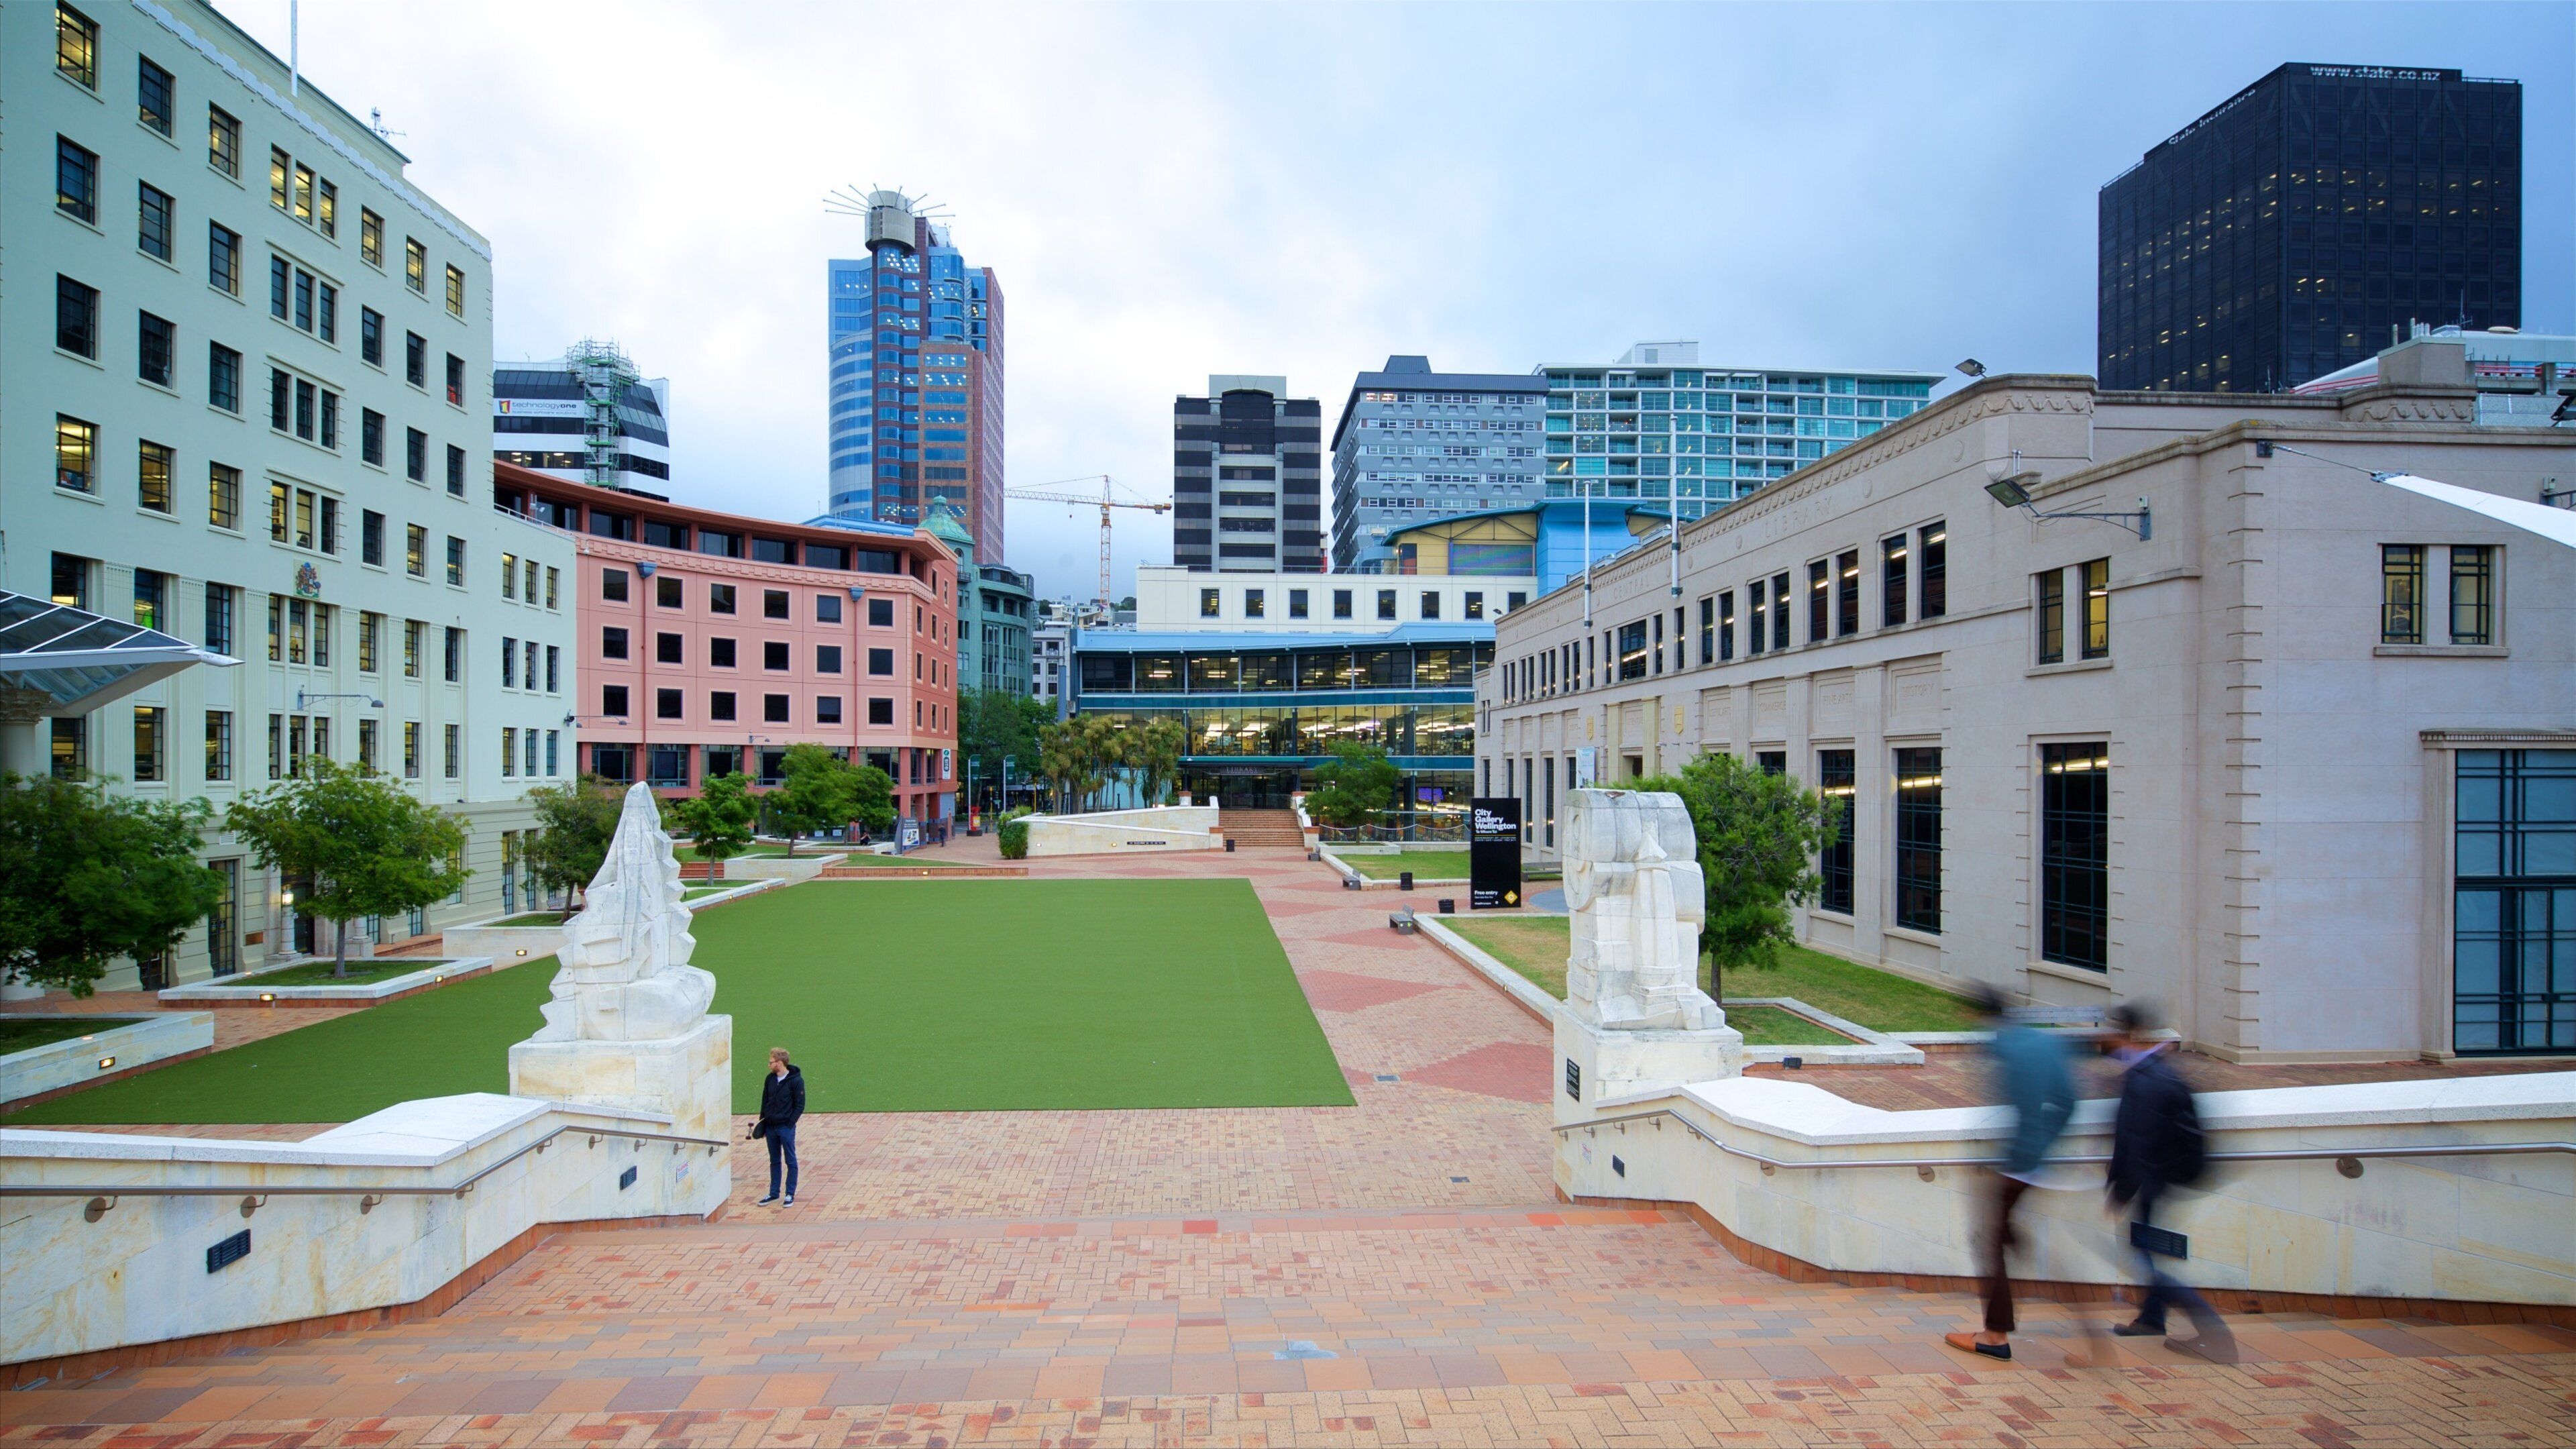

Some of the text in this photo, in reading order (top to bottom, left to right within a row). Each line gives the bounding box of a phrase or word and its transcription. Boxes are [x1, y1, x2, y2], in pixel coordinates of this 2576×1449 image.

[2310, 66, 2440, 81] www.state.co.nz
[512, 401, 577, 409] technologyone
[1765, 496, 1833, 538] LIBRARY
[1474, 808, 1492, 817] City
[1474, 816, 1503, 824] Gallery
[1474, 822, 1516, 831] Wellington
